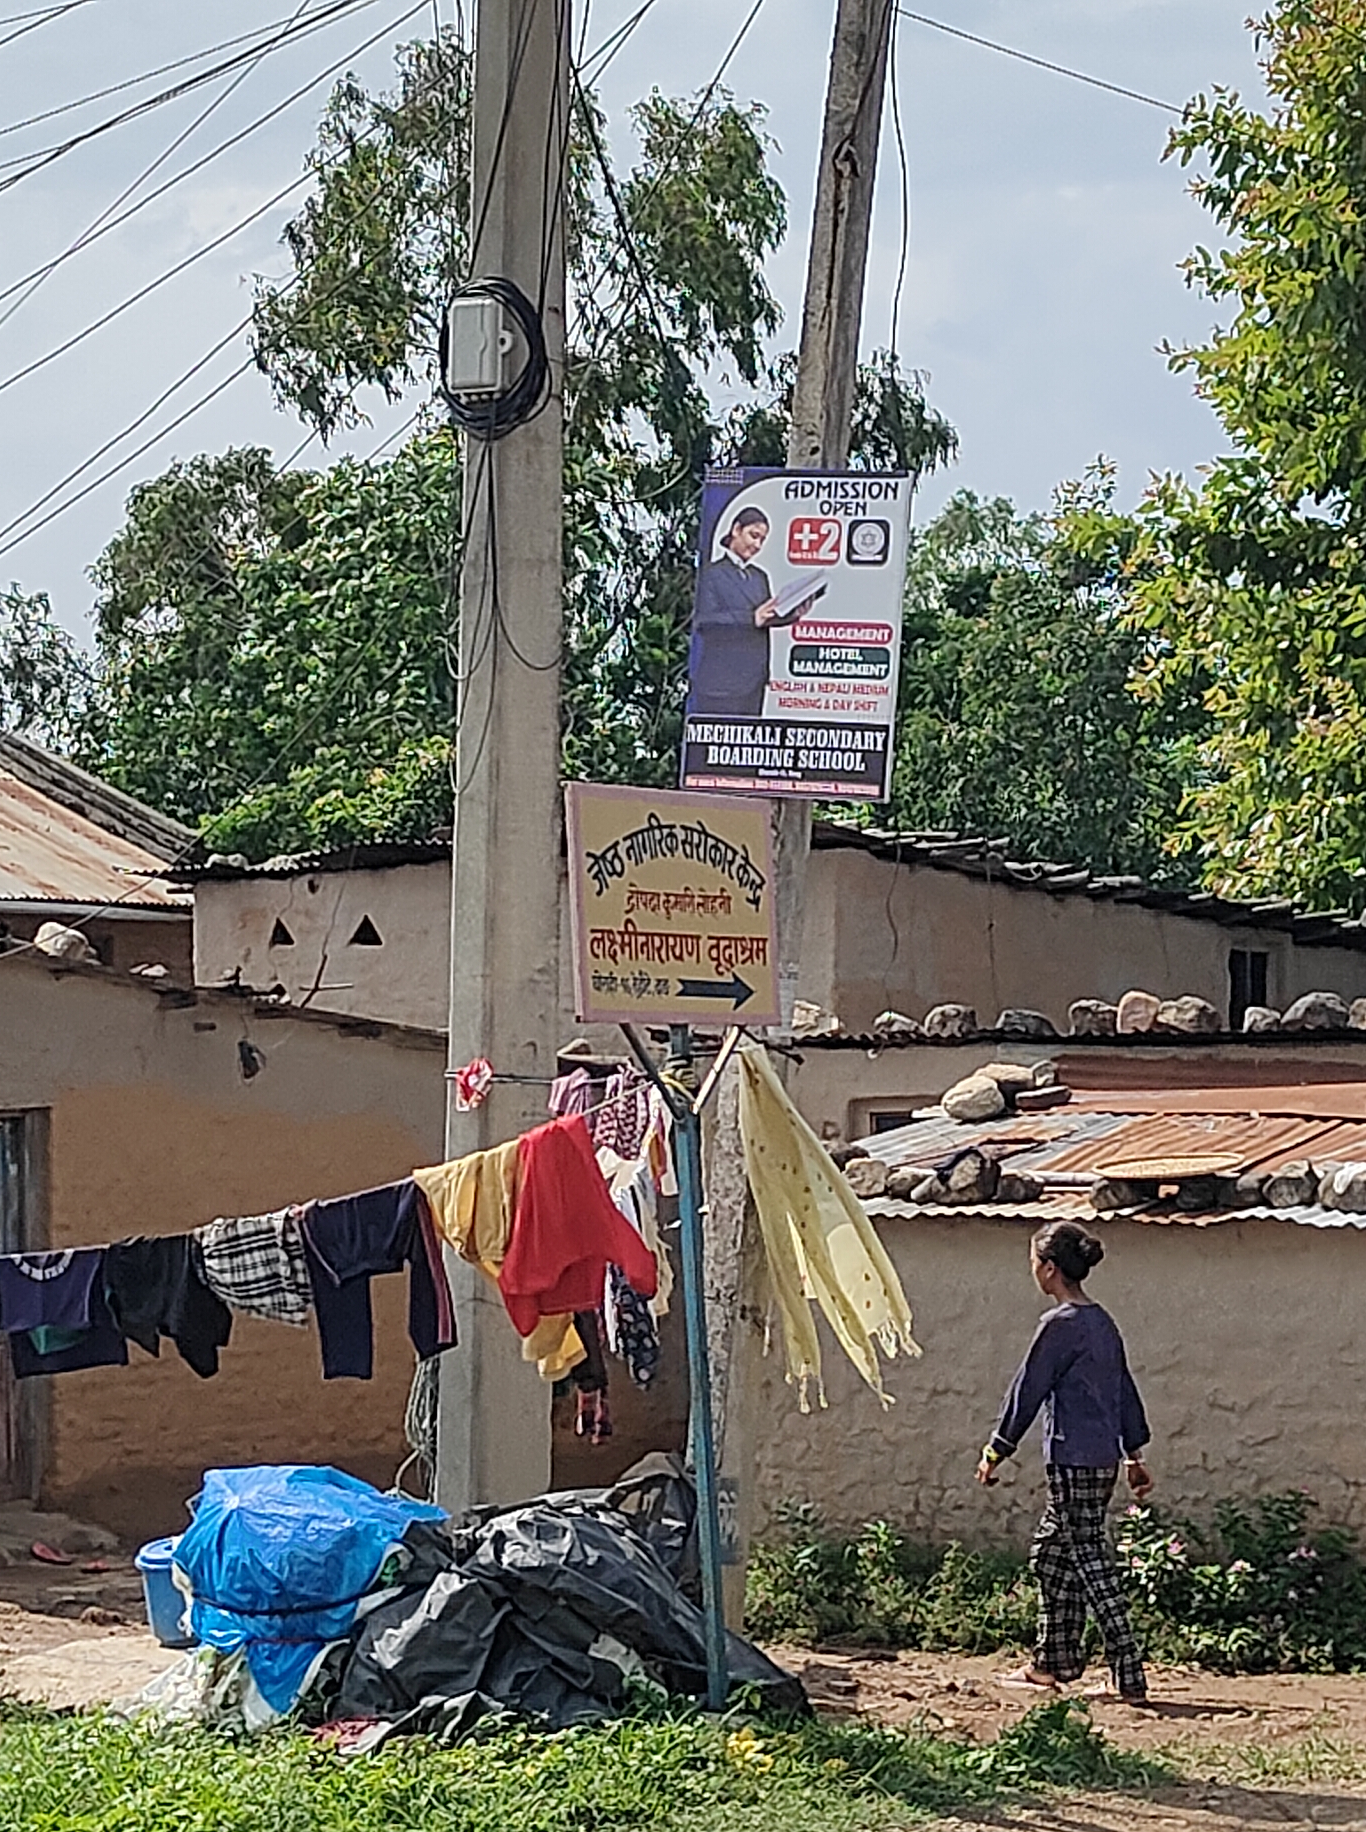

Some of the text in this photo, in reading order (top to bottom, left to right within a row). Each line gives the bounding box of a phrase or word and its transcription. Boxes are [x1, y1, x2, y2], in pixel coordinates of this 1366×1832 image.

[784, 480, 898, 500] ADMISSION
[819, 499, 868, 517] OPEN
[795, 625, 891, 641] MANAGEMENT
[818, 646, 864, 661] HOTEL
[792, 660, 889, 678] MANAGEMENT
[686, 723, 887, 752] MECHIKALI SECONDARY
[707, 745, 866, 773] BOARDING SCHOOL
[621, 812, 678, 867] नागरिक
[679, 820, 740, 881] सरोकार
